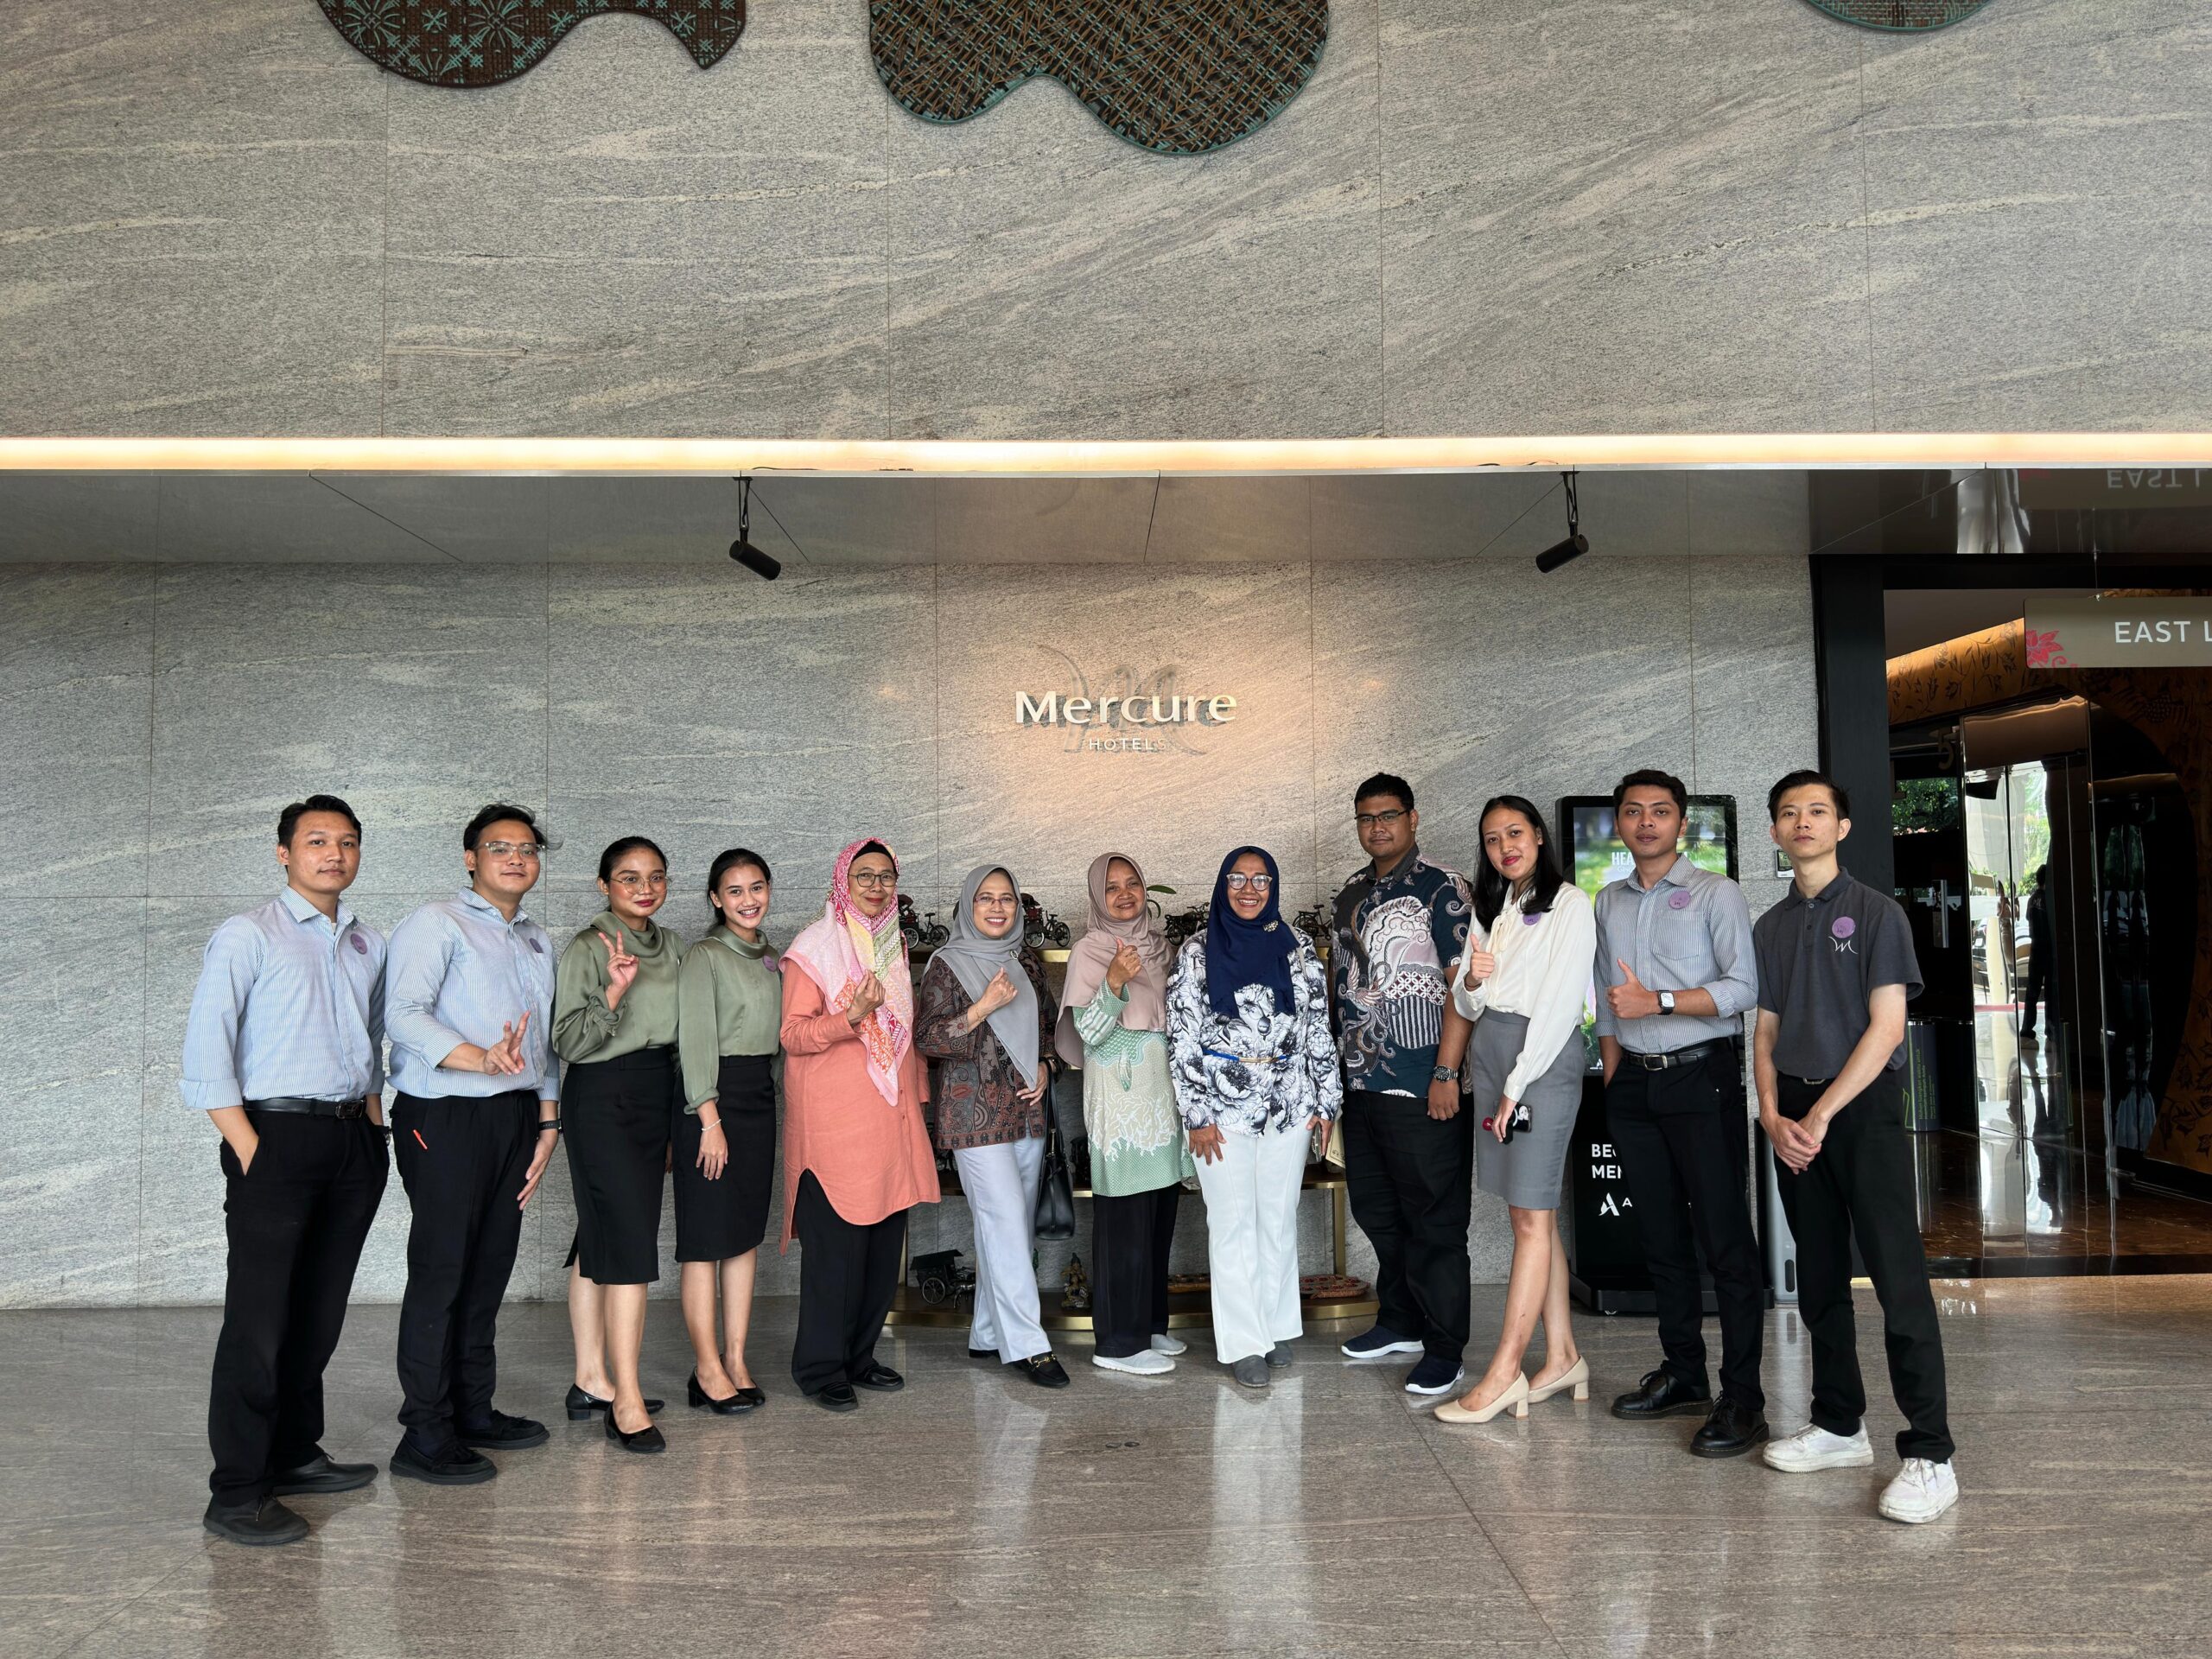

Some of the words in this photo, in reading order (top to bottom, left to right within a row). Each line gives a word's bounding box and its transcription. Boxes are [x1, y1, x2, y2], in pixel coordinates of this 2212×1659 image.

[2114, 621, 2191, 643] EAST
[1015, 690, 1237, 724] Mercure
[1089, 737, 1168, 751] HOTELS
[1611, 852, 1635, 865] HEA
[1592, 1144, 1617, 1158] BE
